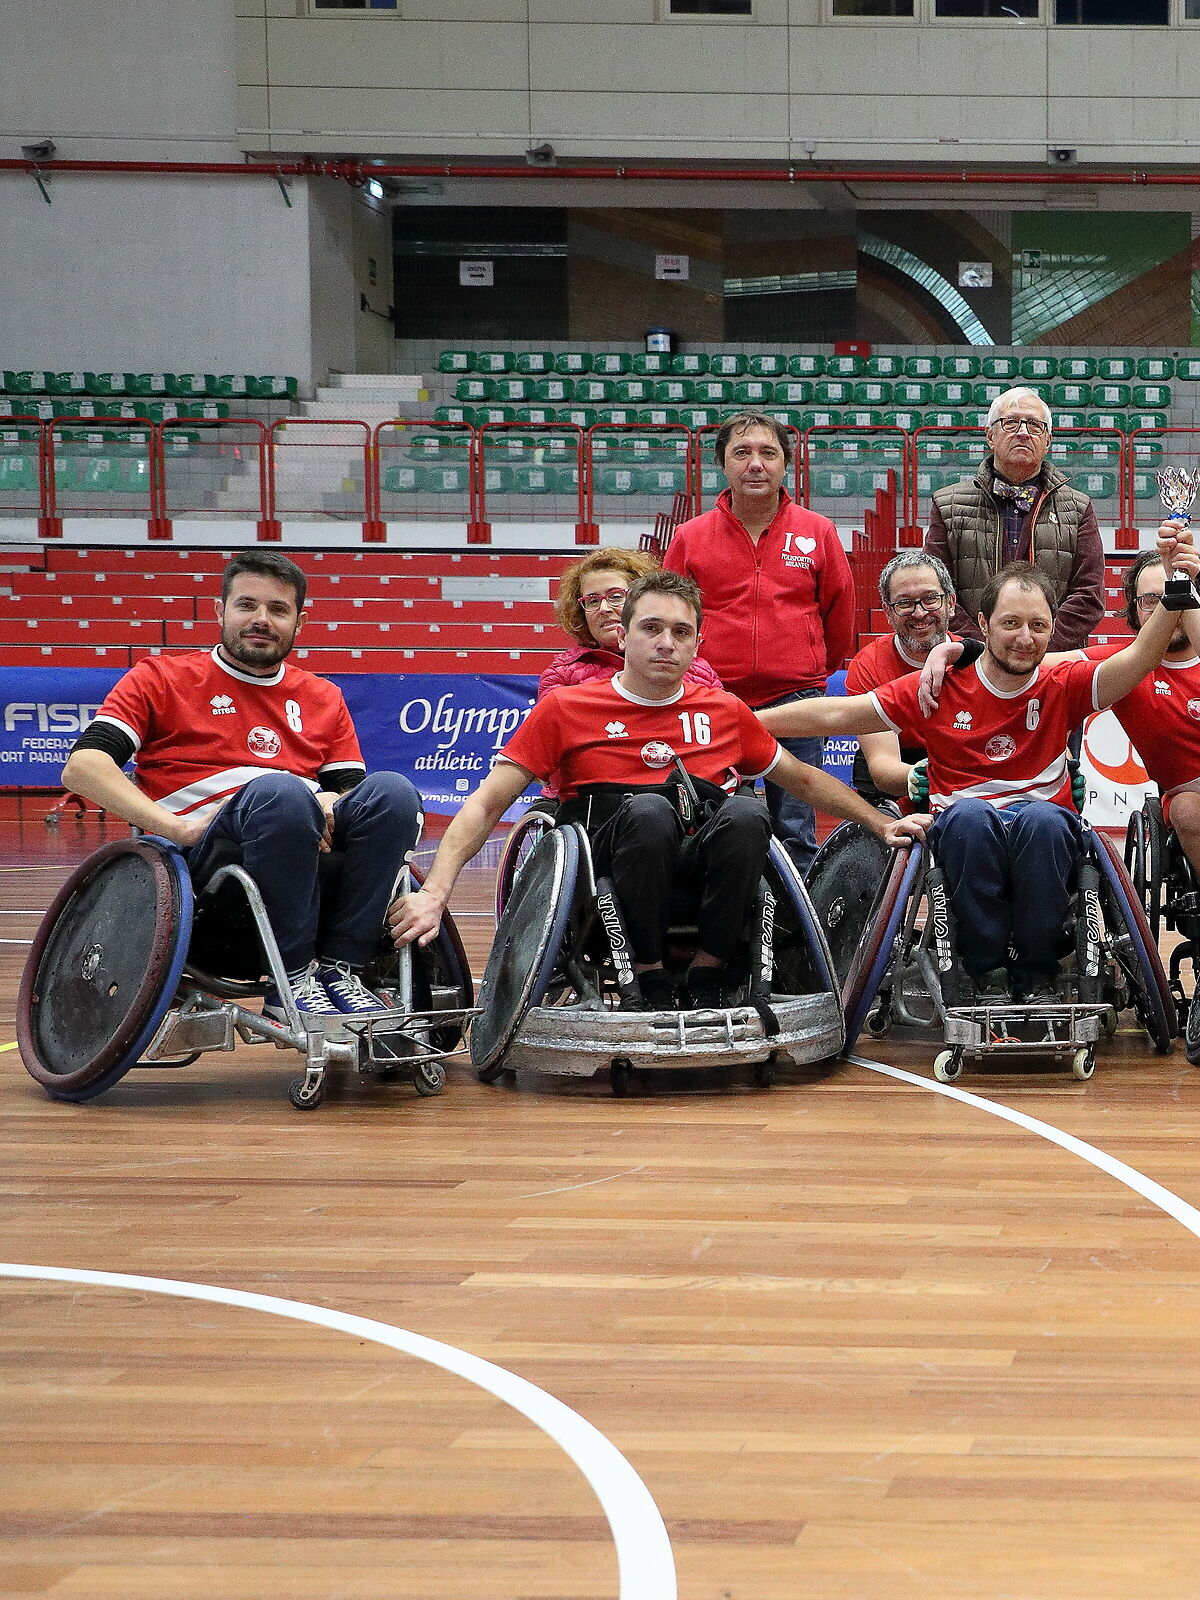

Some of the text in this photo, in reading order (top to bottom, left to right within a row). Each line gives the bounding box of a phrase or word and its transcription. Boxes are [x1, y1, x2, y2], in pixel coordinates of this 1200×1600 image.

[782, 532, 795, 553] I
[4, 702, 105, 733] FISP
[285, 699, 303, 733] 8
[399, 692, 536, 750] Olympi
[1026, 698, 1040, 731] 6
[677, 711, 712, 746] 16
[0, 751, 25, 762] ORT
[22, 737, 77, 750] FEDERAZ
[823, 740, 860, 752] RAZIO
[414, 749, 483, 771] athletic
